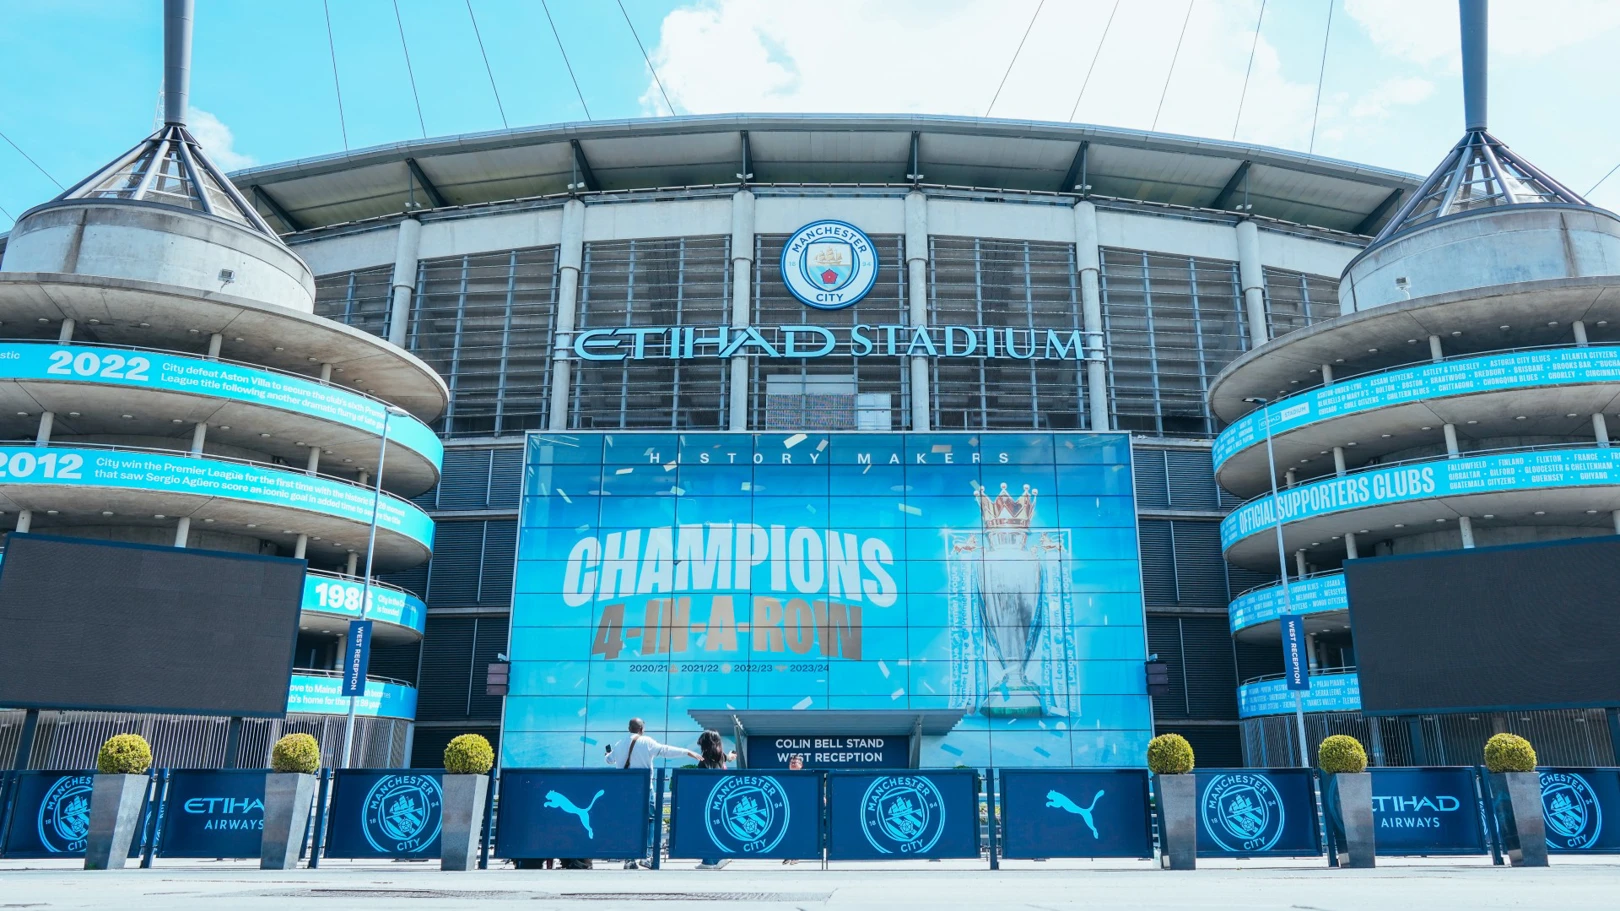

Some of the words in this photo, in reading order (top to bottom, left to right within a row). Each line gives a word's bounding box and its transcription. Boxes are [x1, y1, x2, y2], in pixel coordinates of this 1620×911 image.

[792, 226, 867, 253] MANCHESTER
[816, 293, 844, 302] CITY
[573, 325, 837, 361] ETIHAD
[851, 324, 1086, 361] STADIUM
[47, 350, 150, 381] 2022
[1371, 377, 1388, 386] ASSAM
[1390, 372, 1414, 383] CITYZENS
[1423, 367, 1442, 377] ASTLEY
[1444, 365, 1449, 373] &
[1450, 361, 1480, 371] TYLDESLEY
[1490, 358, 1515, 368] ASTORIA
[1516, 356, 1531, 365] CITY
[1532, 354, 1551, 363] BLUES
[1561, 352, 1588, 361] ATLANTA
[1589, 350, 1617, 360] CITYZENS
[162, 362, 184, 375] City
[186, 366, 218, 378] defeat
[220, 371, 249, 383] Aston
[251, 376, 271, 388] Villa
[272, 381, 281, 390] to
[283, 385, 311, 397] secure
[312, 391, 325, 400] the
[1376, 384, 1395, 394] BOLTON
[1402, 379, 1422, 389] BOSTON
[1431, 372, 1466, 384] BRANTWOOD
[1474, 368, 1505, 378] BREDBURY
[1513, 364, 1543, 374] BRISBANE
[1552, 361, 1577, 371] BROOKS
[1578, 361, 1591, 369] BAR
[1412, 387, 1429, 395] BLUES
[1438, 381, 1474, 391] CHITTAGONG
[1483, 376, 1518, 386] CHONGQING
[1519, 373, 1538, 382] BLUES
[1548, 371, 1575, 380] CHORLEY
[161, 373, 198, 386] League
[201, 378, 220, 389] title
[222, 382, 266, 399] following
[267, 391, 300, 404] another
[302, 399, 336, 414] dramatic
[1284, 405, 1306, 418] STADIUM
[650, 452, 822, 465] HISTORY
[858, 452, 1009, 464] MAKERS
[1448, 461, 1487, 471] FALLOWFIELD
[1498, 457, 1524, 466] FINLAND
[1536, 455, 1562, 463] FLIXTON
[1574, 453, 1598, 461] FRANCE
[96, 457, 119, 470] City
[122, 459, 142, 470] win
[144, 461, 162, 471] the
[164, 463, 206, 476] Premier
[207, 468, 243, 481] League
[245, 473, 259, 483] for
[260, 475, 275, 485] the
[276, 478, 294, 489] first
[295, 482, 314, 492] time
[315, 485, 332, 496] with
[332, 489, 344, 499] the
[345, 492, 369, 505] historic
[1449, 470, 1481, 480] GIBRALTAR
[1524, 464, 1563, 473] GLOUCESTER
[1565, 463, 1570, 471] &
[1571, 461, 1613, 471] CHELTENHAM
[1450, 480, 1485, 489] GUATEMALA
[1488, 477, 1516, 486] CITYZENS
[1532, 473, 1564, 482] GUERNSEY
[1580, 472, 1608, 480] GUIYANG
[94, 469, 118, 479] that
[120, 472, 144, 482] saw
[146, 473, 181, 485] Sergio
[182, 476, 220, 488] Agüero
[221, 481, 249, 492] score
[250, 486, 263, 494] an
[263, 486, 289, 498] iconic
[290, 492, 309, 502] goal
[309, 494, 317, 503] in
[317, 497, 341, 508] added
[341, 502, 357, 512] time
[1239, 501, 1277, 535] OFFICIAL
[1277, 476, 1370, 520] SUPPORTERS
[1373, 467, 1435, 499] CLUBS
[562, 523, 898, 608] CHAMPIONS
[315, 582, 373, 613] 1986
[591, 595, 862, 661] 4-IN-A-ROW
[1063, 601, 1073, 633] Premier
[355, 626, 364, 647] WEST
[1288, 620, 1297, 642] WEST
[350, 648, 361, 691] RECEPTION
[629, 664, 669, 674] 2020/21
[681, 664, 719, 674] 2021/22
[734, 664, 773, 674] 2022/23
[790, 664, 830, 674] 2023/24
[1290, 643, 1301, 684] RECEPTION
[290, 684, 304, 692] ove
[305, 684, 313, 692] to
[314, 683, 336, 694] Maine
[303, 695, 323, 704] home
[324, 696, 334, 705] for
[775, 739, 811, 749] COLIN
[814, 739, 843, 748] BELL
[846, 739, 884, 748] STAND
[815, 753, 883, 762] RECEPTION
[47, 776, 93, 810] MANCHES
[370, 776, 434, 809] MANCHESTER
[713, 776, 776, 810] MANCHESTER
[868, 777, 930, 811] MANCHESTER
[1209, 775, 1268, 808] MANCHESTER
[1540, 774, 1584, 793] CHESTER
[184, 797, 265, 814] ETIHA
[204, 819, 264, 830] AIRWAYS
[1381, 817, 1440, 828] AIRWAYS
[397, 838, 420, 851] CITY
[743, 839, 767, 852] CITY
[900, 839, 923, 852] CITY
[1244, 837, 1266, 850] CITY
[1567, 834, 1587, 848] CITY
